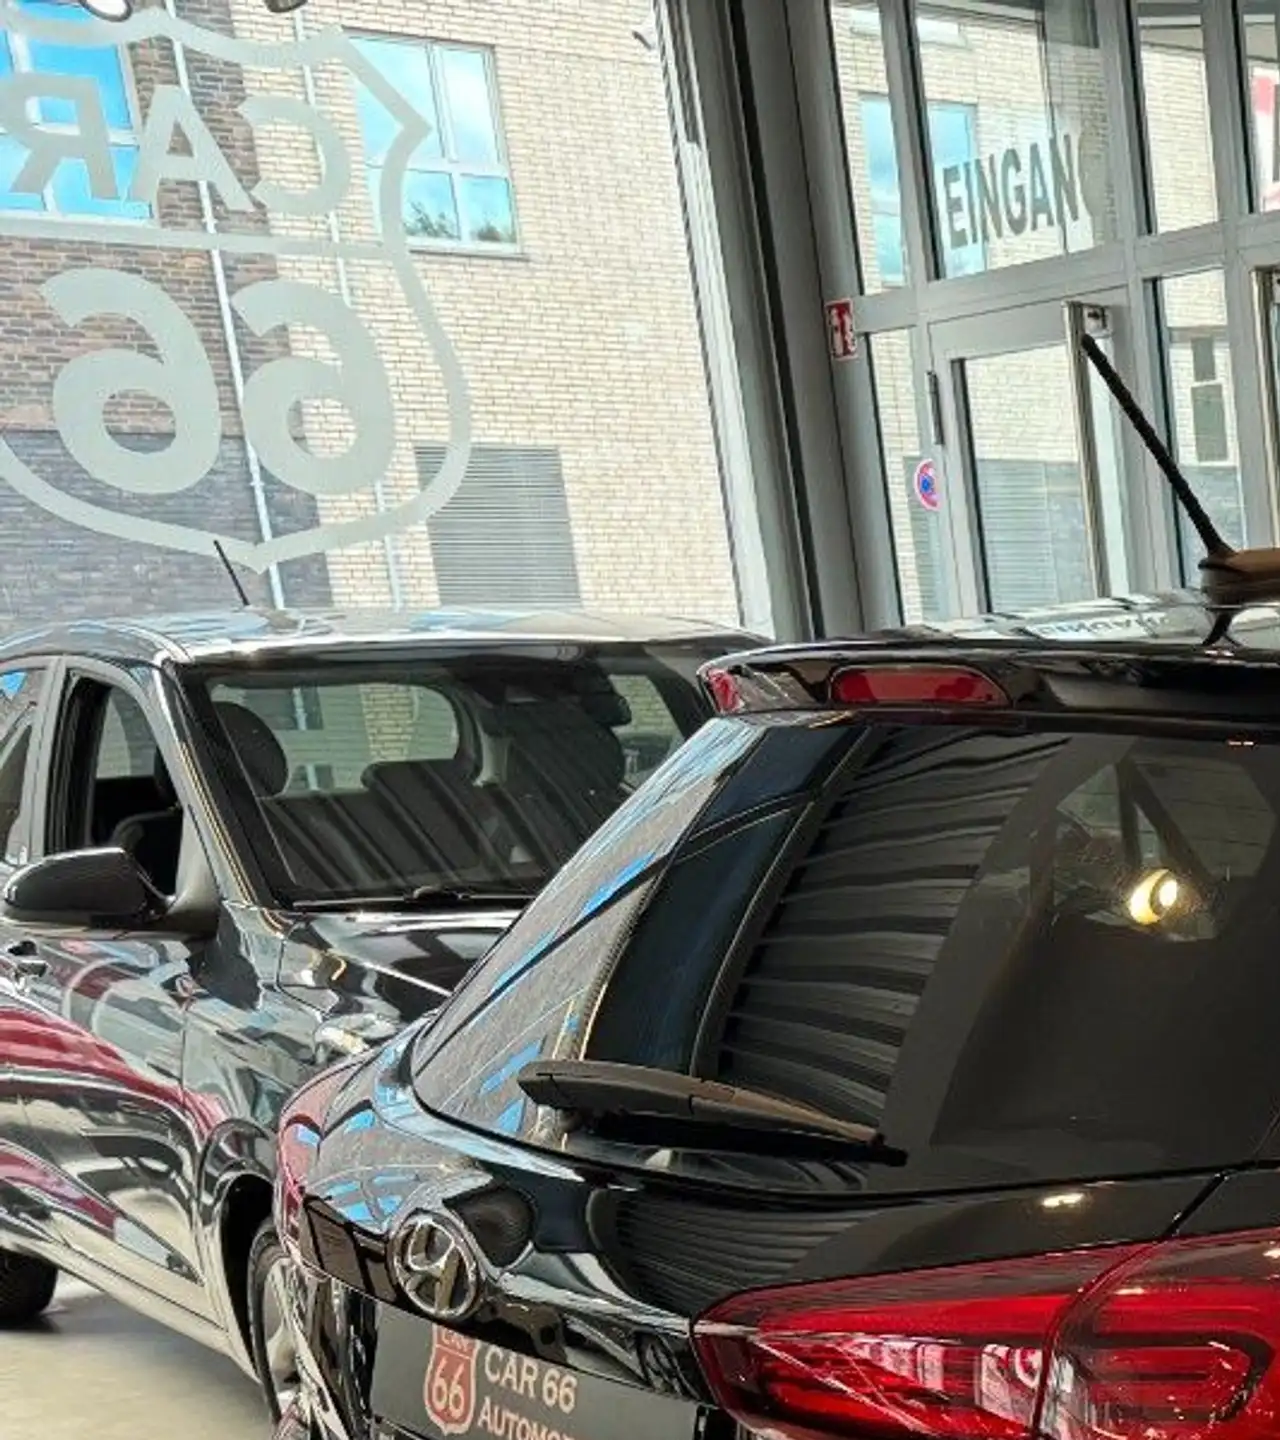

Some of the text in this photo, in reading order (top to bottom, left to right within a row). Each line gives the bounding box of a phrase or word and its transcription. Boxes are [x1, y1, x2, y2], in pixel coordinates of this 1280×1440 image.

[432, 1354, 465, 1419] 66
[485, 1347, 578, 1414] CAR 66
